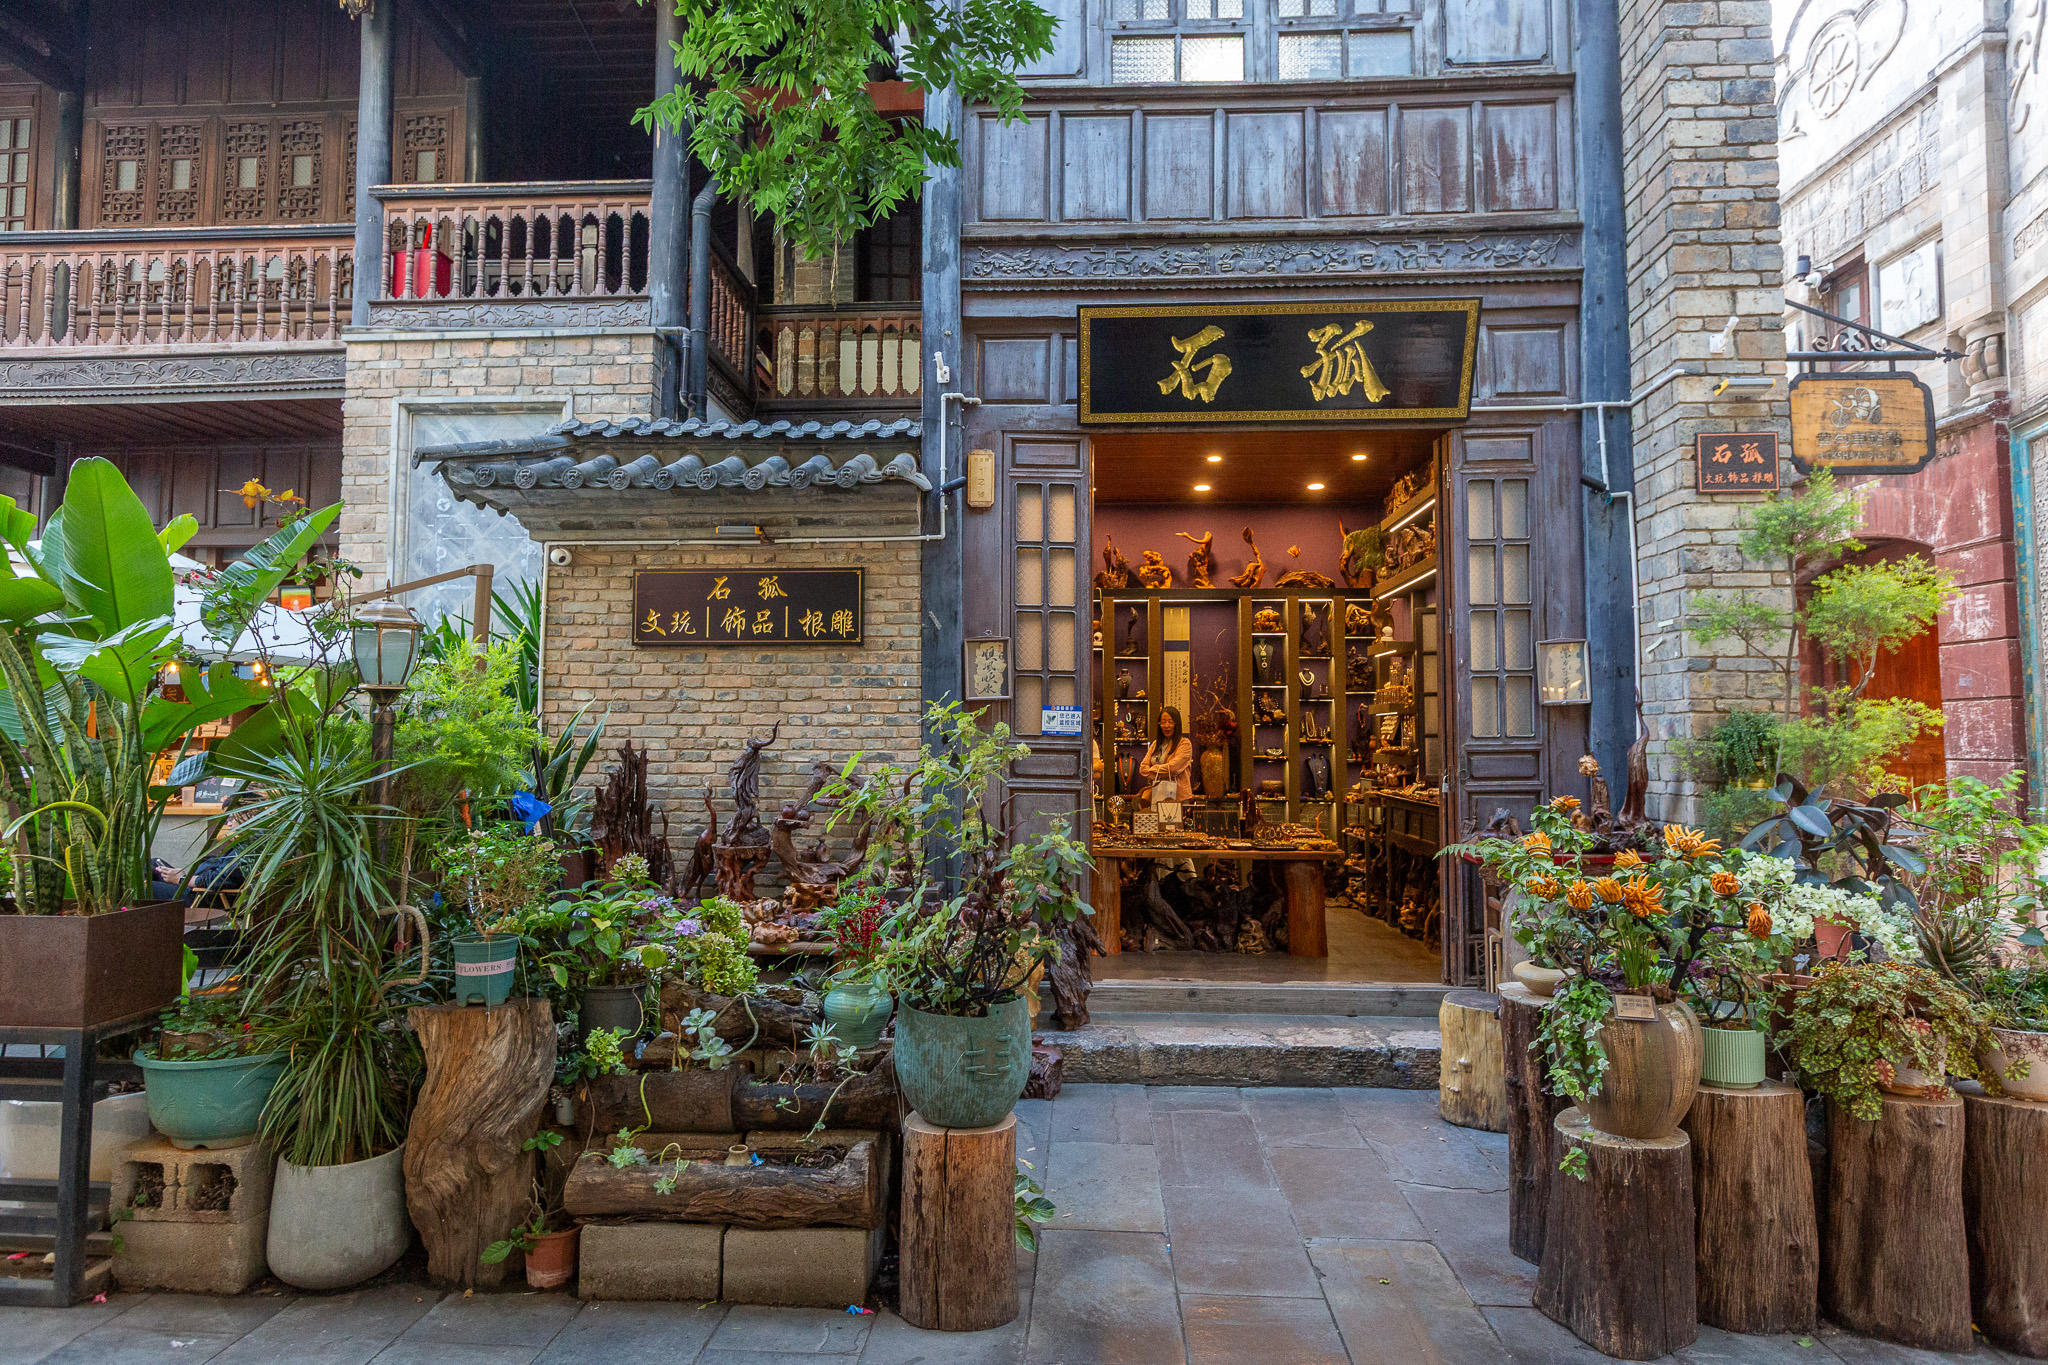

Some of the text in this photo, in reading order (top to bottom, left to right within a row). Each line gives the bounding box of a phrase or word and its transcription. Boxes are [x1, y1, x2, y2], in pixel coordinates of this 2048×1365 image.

[1157, 320, 1391, 403] 石孤
[1712, 443, 1765, 464] 石孤
[1818, 451, 1863, 459] RCKSHAW
[707, 576, 787, 600] 石孤
[641, 606, 854, 638] 文玩 饰品 根雕
[460, 964, 502, 974] FLOWERS
